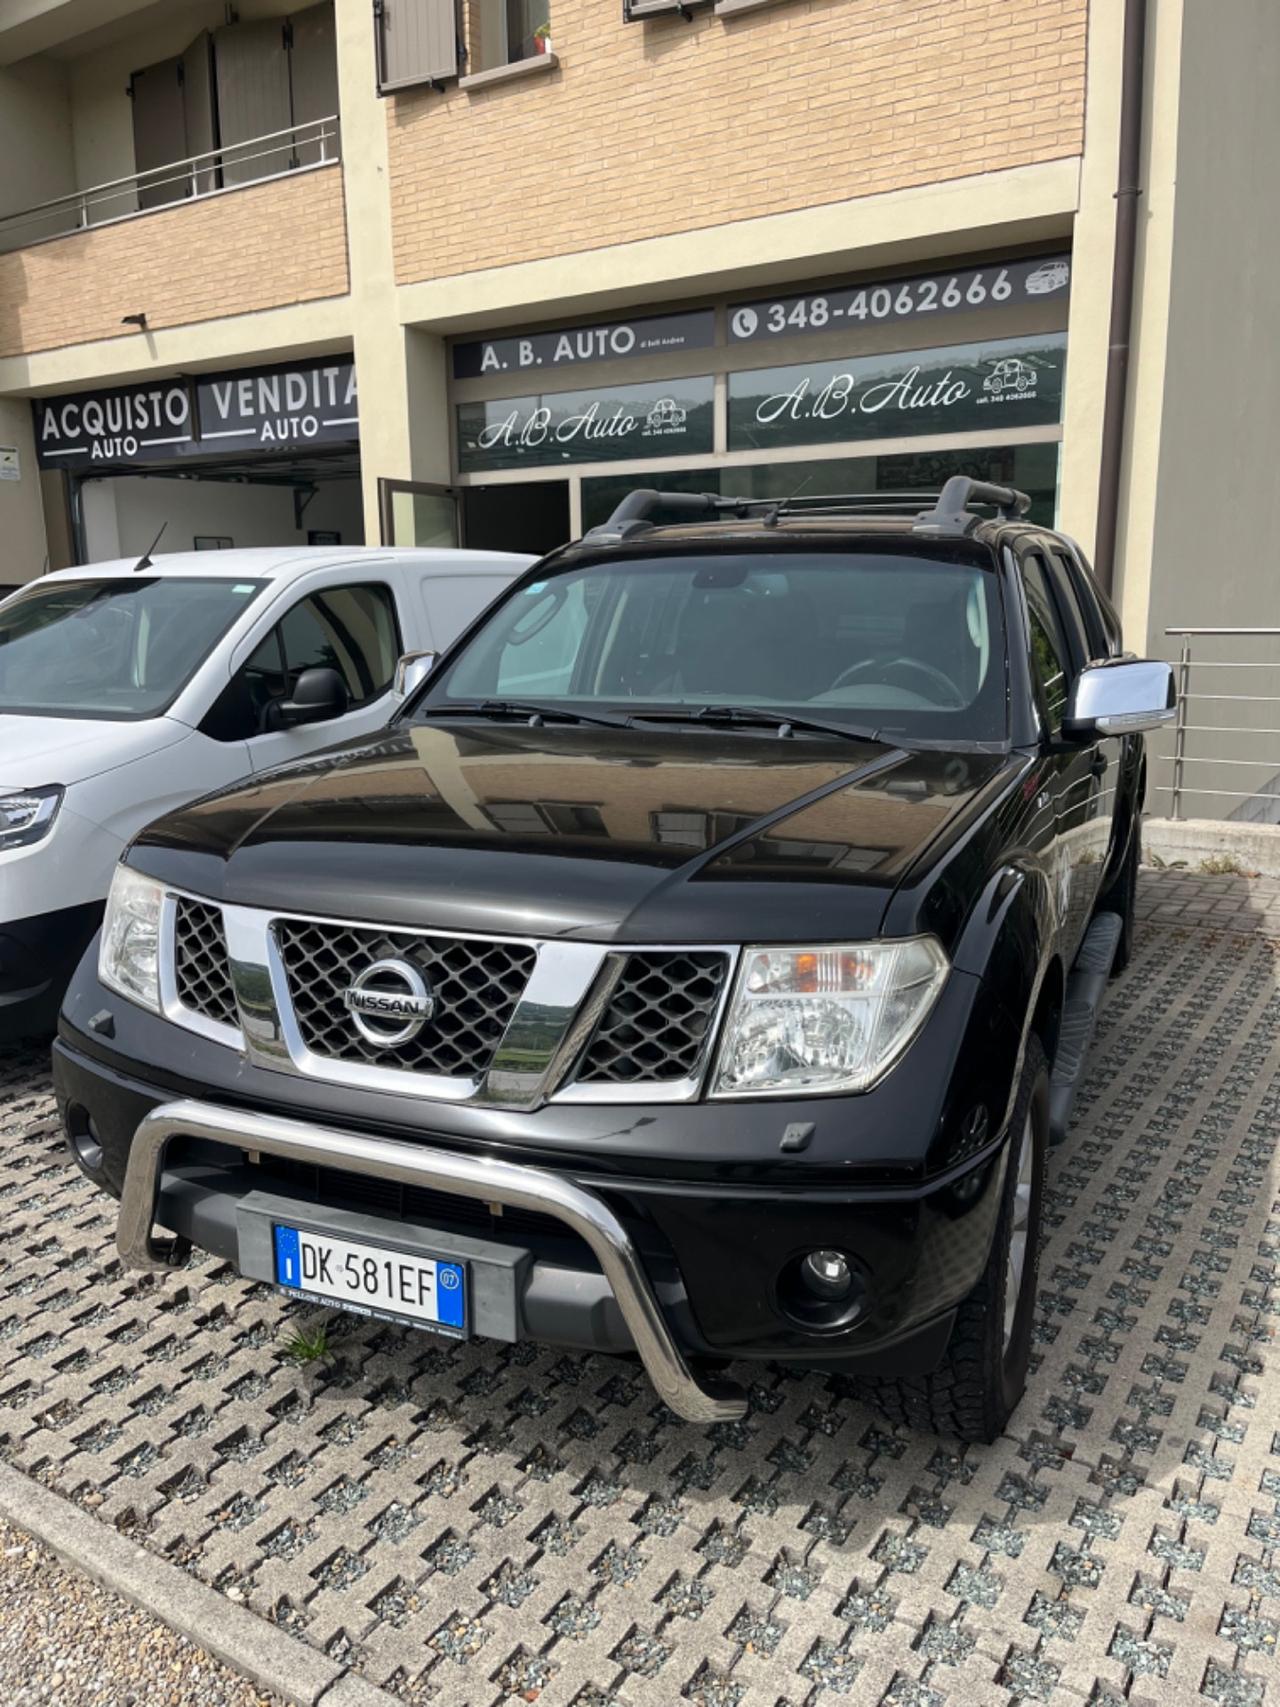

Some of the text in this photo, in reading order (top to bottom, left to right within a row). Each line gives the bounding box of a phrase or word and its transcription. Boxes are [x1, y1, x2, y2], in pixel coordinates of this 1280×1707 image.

[766, 269, 1012, 333] 348-4062666
[480, 326, 636, 372] A. B. AUTO
[42, 387, 190, 441] ACQUISTO
[260, 414, 319, 442] AUTO
[91, 435, 138, 460] AUTO
[350, 992, 419, 1013] NISSAN
[301, 1242, 434, 1306] DK 581EF
